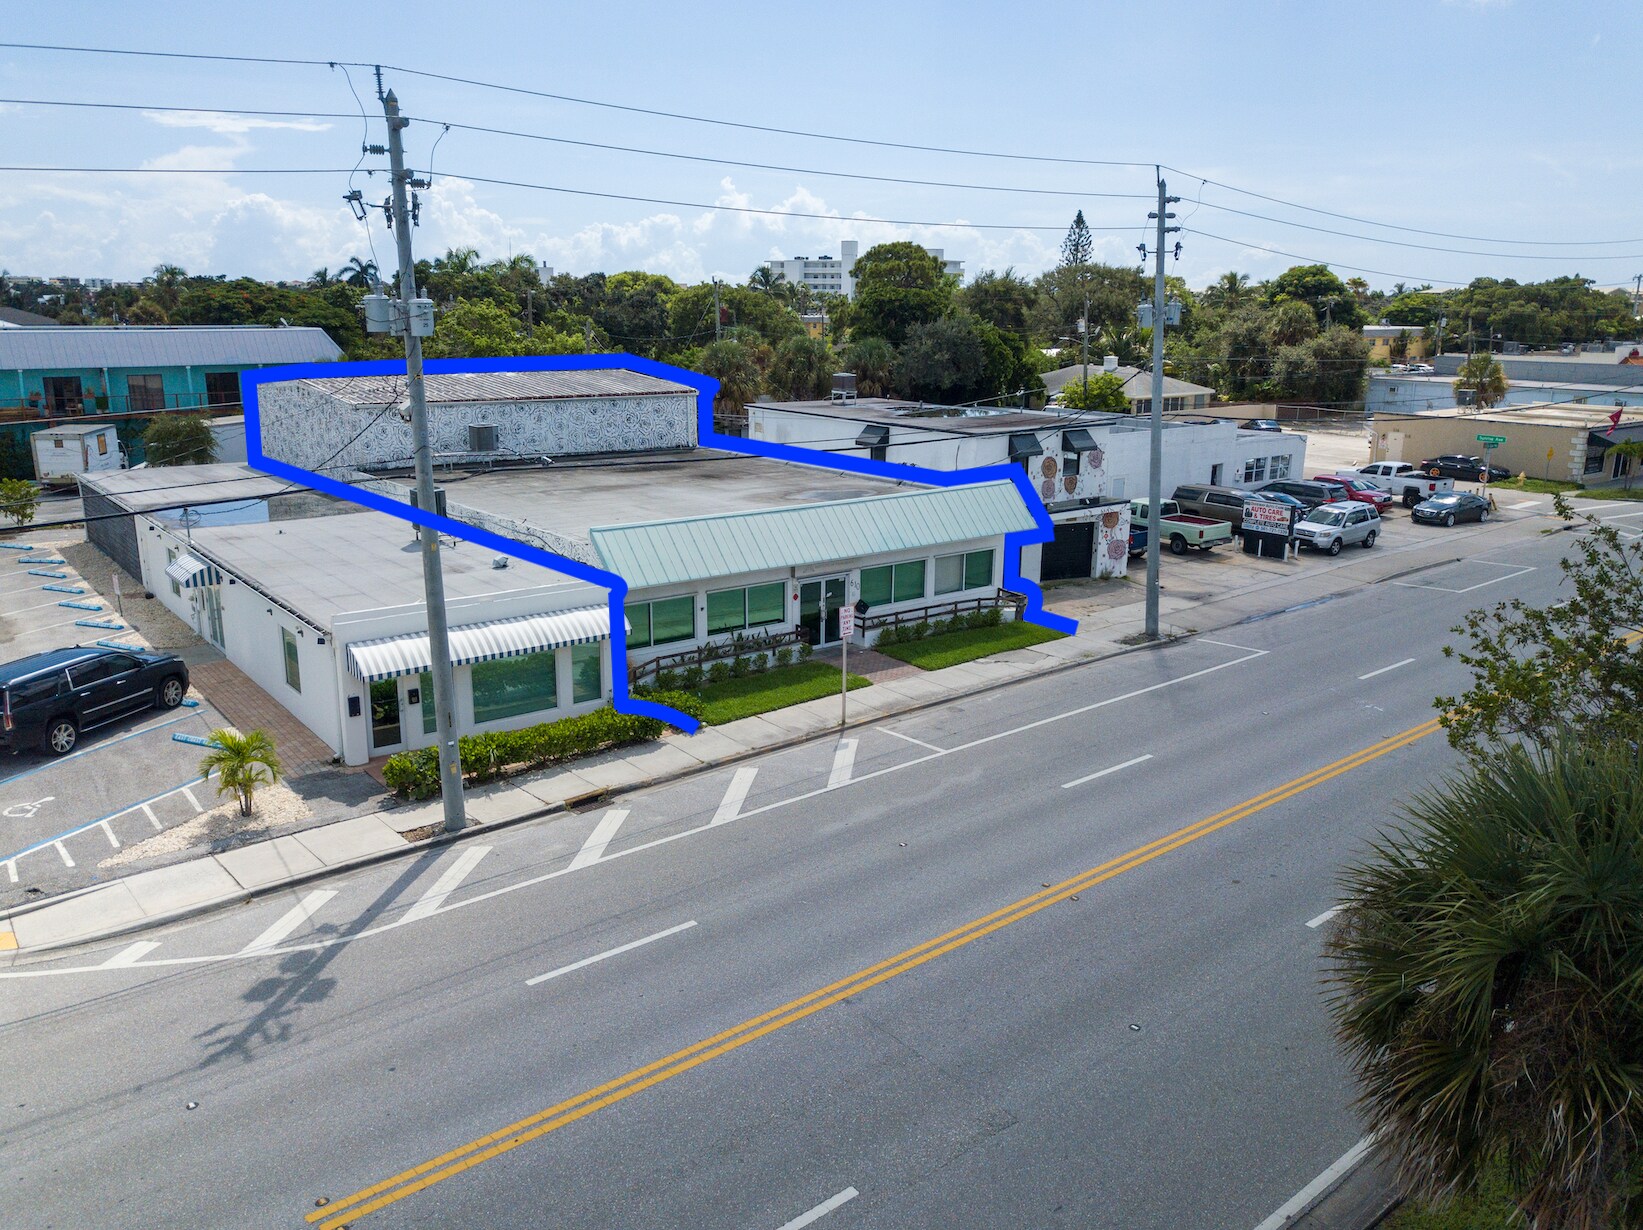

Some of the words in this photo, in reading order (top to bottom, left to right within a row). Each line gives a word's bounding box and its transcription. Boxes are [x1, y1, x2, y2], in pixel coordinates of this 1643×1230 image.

[1251, 506, 1266, 514] AUTO
[1267, 508, 1284, 516] CARE
[1259, 514, 1277, 522] TIRES
[850, 579, 860, 590] 610
